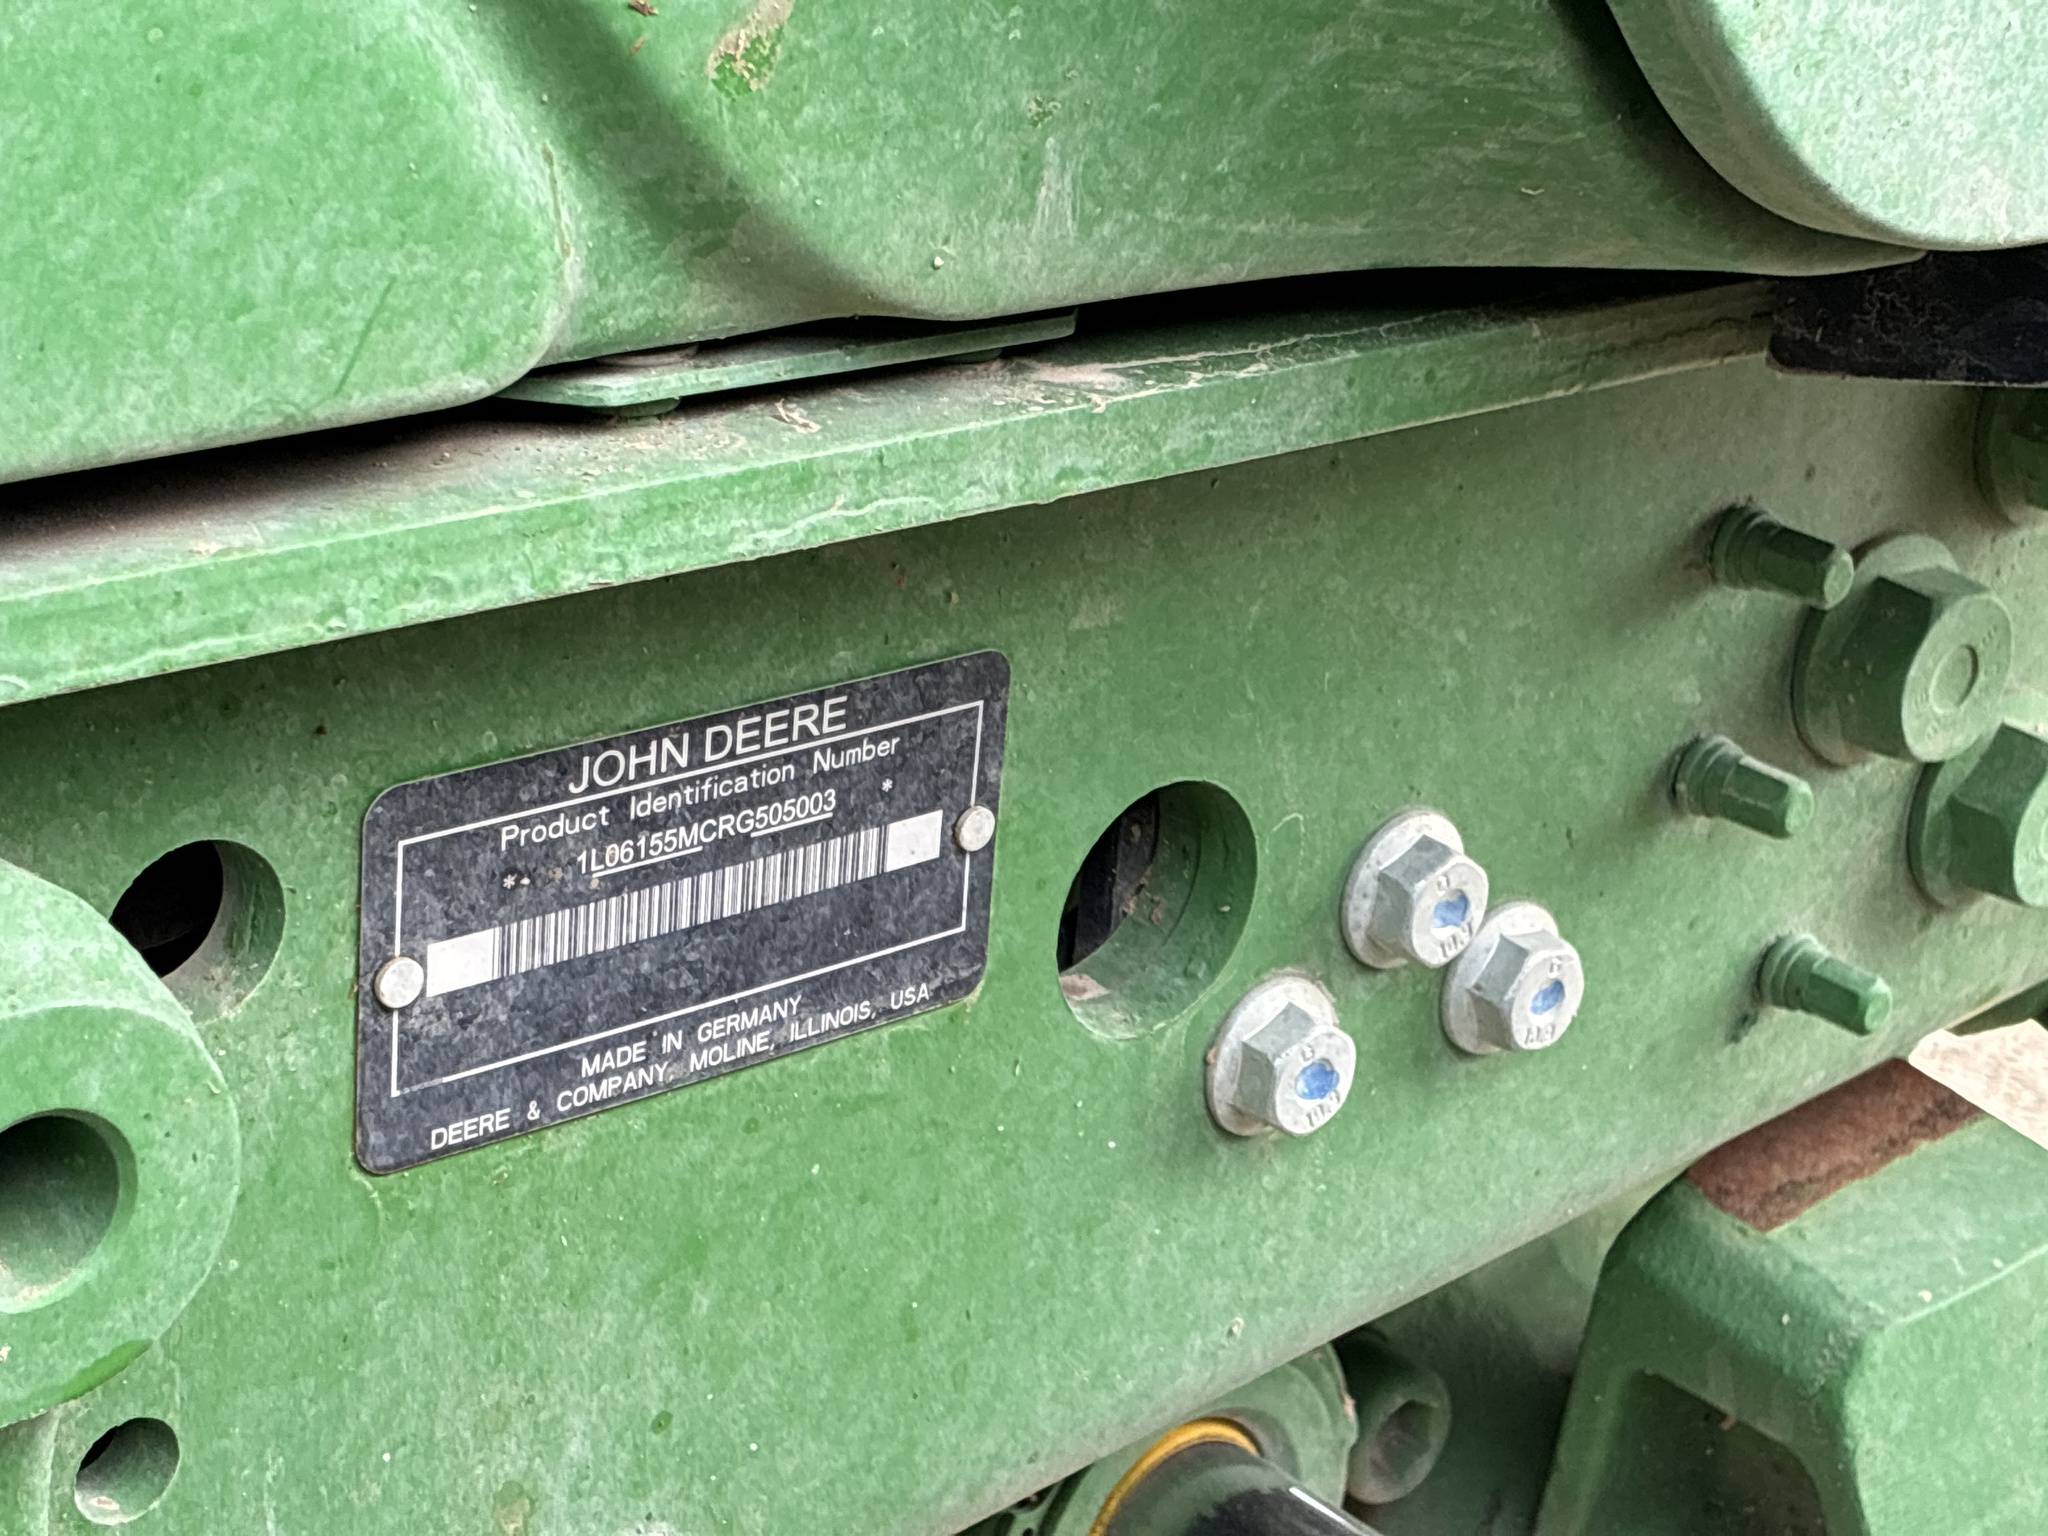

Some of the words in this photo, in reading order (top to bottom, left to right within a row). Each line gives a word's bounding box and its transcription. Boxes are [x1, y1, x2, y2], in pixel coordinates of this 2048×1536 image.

[501, 805, 610, 851] Product
[630, 764, 795, 820] Identification
[813, 735, 901, 774] Number
[569, 733, 689, 794] JOHN
[705, 695, 848, 763] DEERE
[577, 789, 837, 876] 1L06155MCRG505003
[431, 1107, 510, 1150] DEERE
[527, 1101, 541, 1121] &
[690, 1031, 775, 1074] MOLINE,
[790, 1000, 878, 1042] ILLINOIS,
[890, 982, 930, 1009] USA
[581, 1041, 647, 1078] MADE
[662, 1030, 683, 1055] IN
[698, 994, 803, 1043] GERMANY
